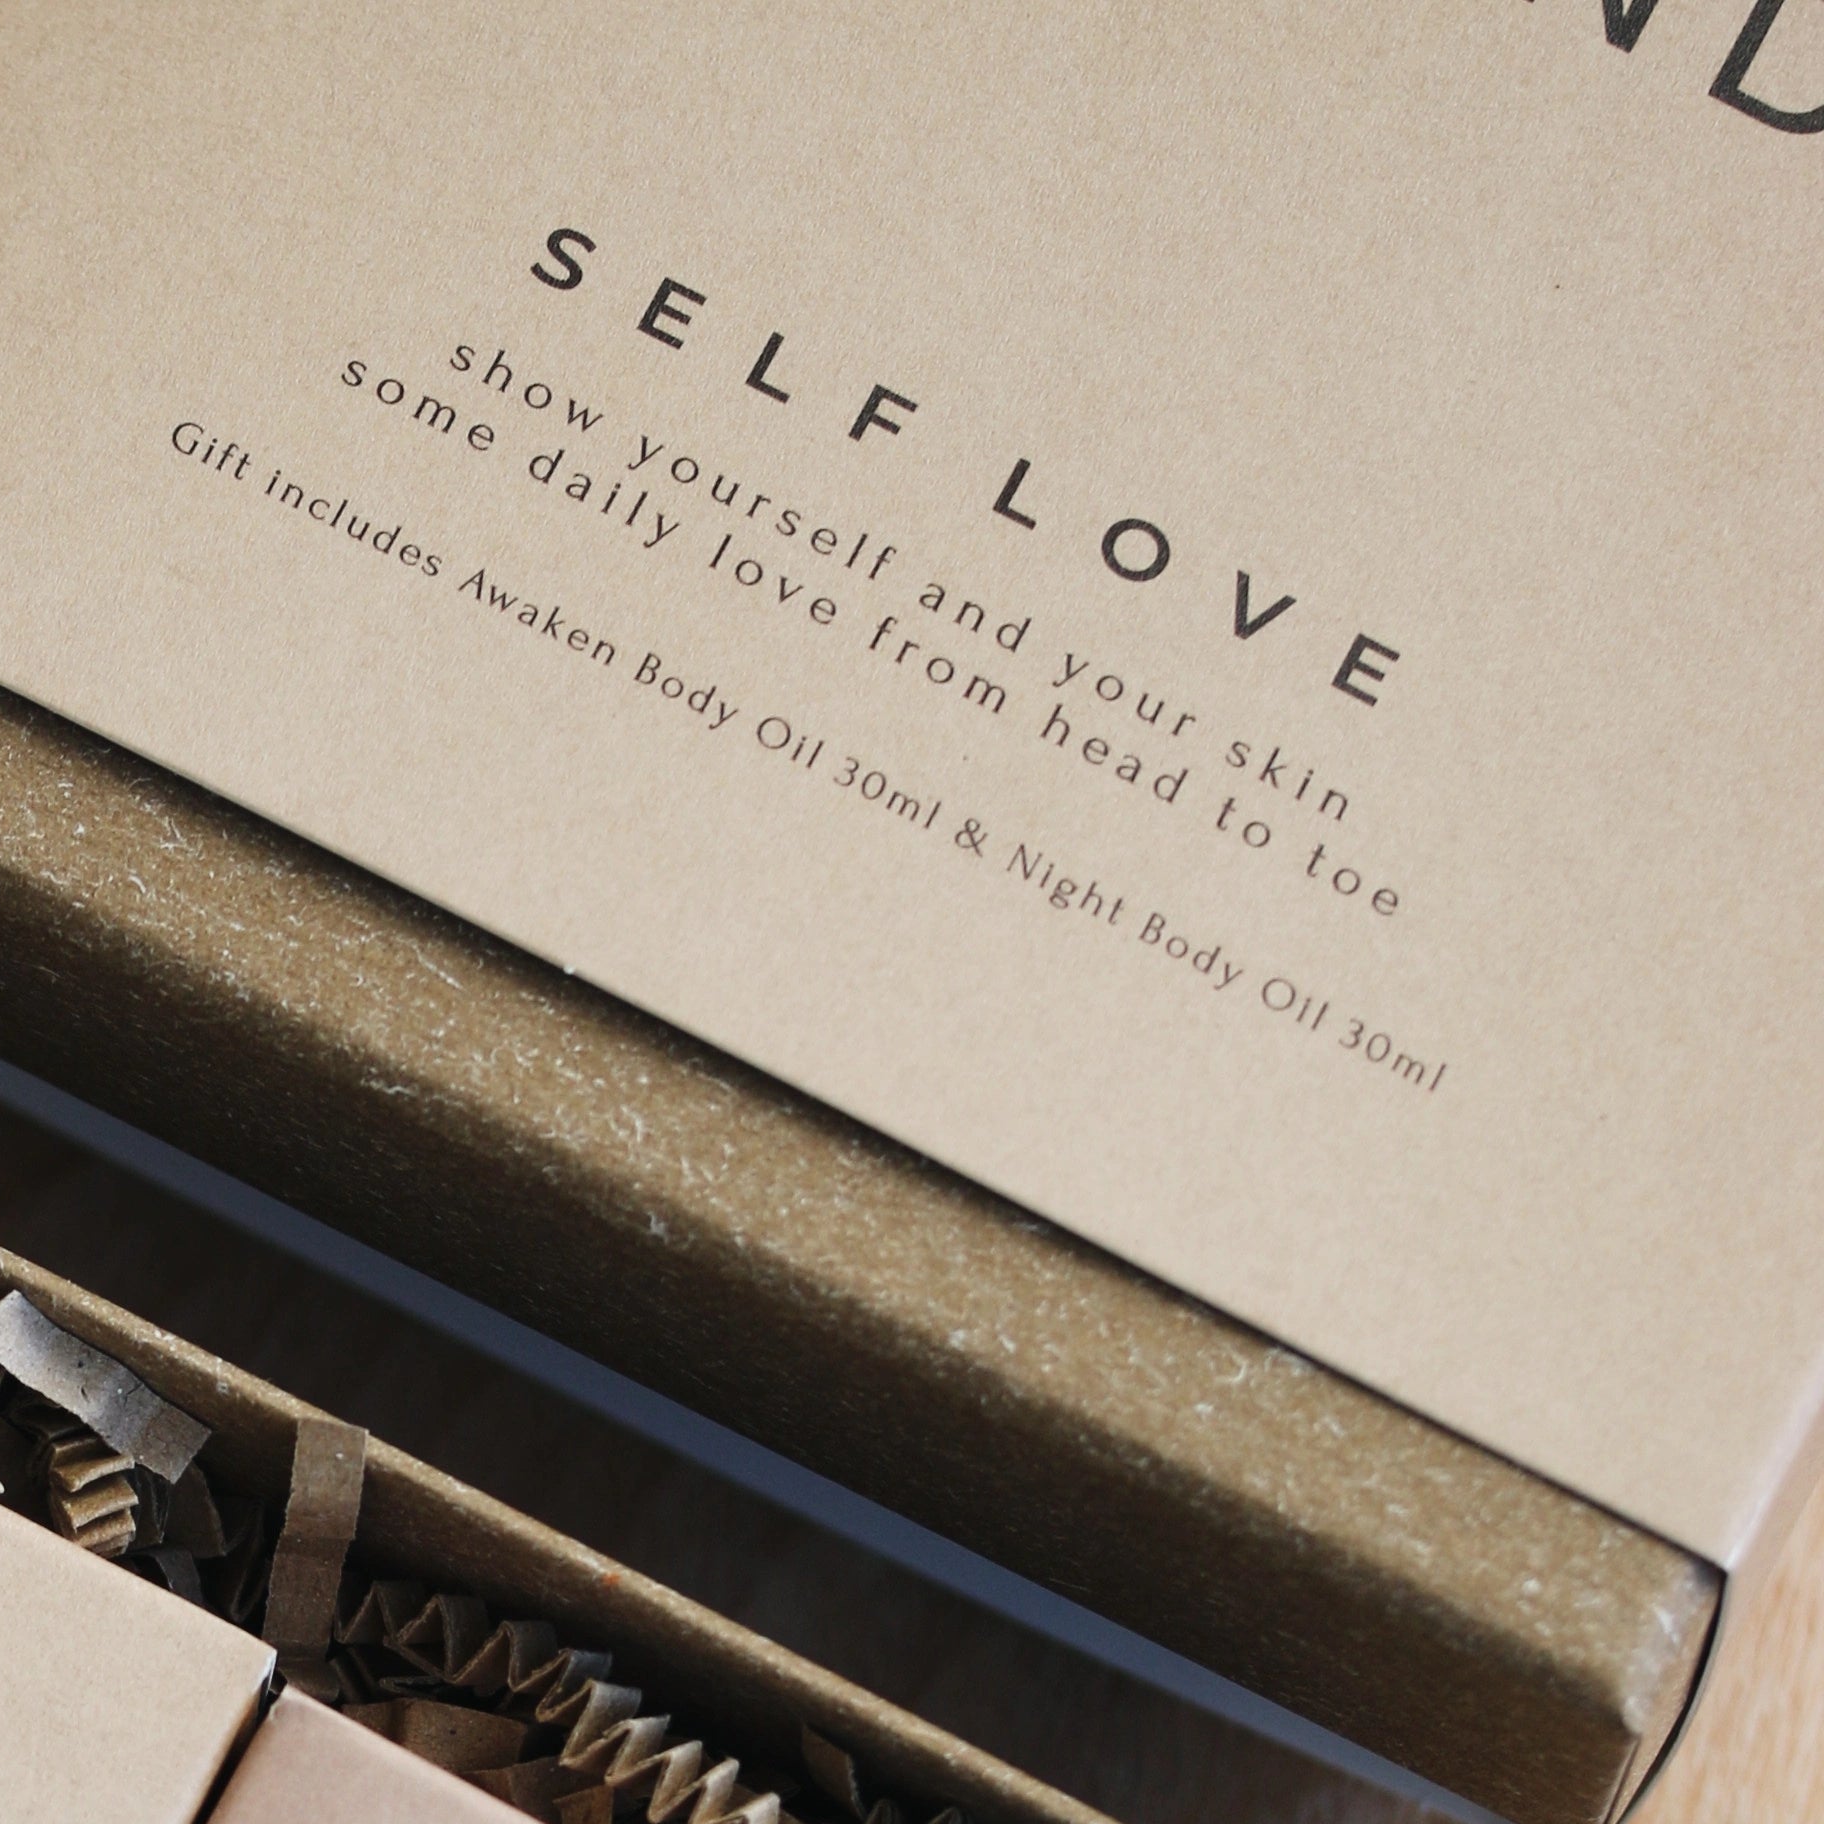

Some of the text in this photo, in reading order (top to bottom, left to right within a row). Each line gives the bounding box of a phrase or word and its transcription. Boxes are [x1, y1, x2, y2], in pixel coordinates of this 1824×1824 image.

[340, 360, 1399, 916] some daily love from head to toe
[449, 344, 1348, 822] show yourself and your skin
[530, 227, 1400, 707] SELF LOVE
[171, 421, 1448, 1093] Gift includes Awaken Body Oil 30ml & Night Body Oil 30ml
